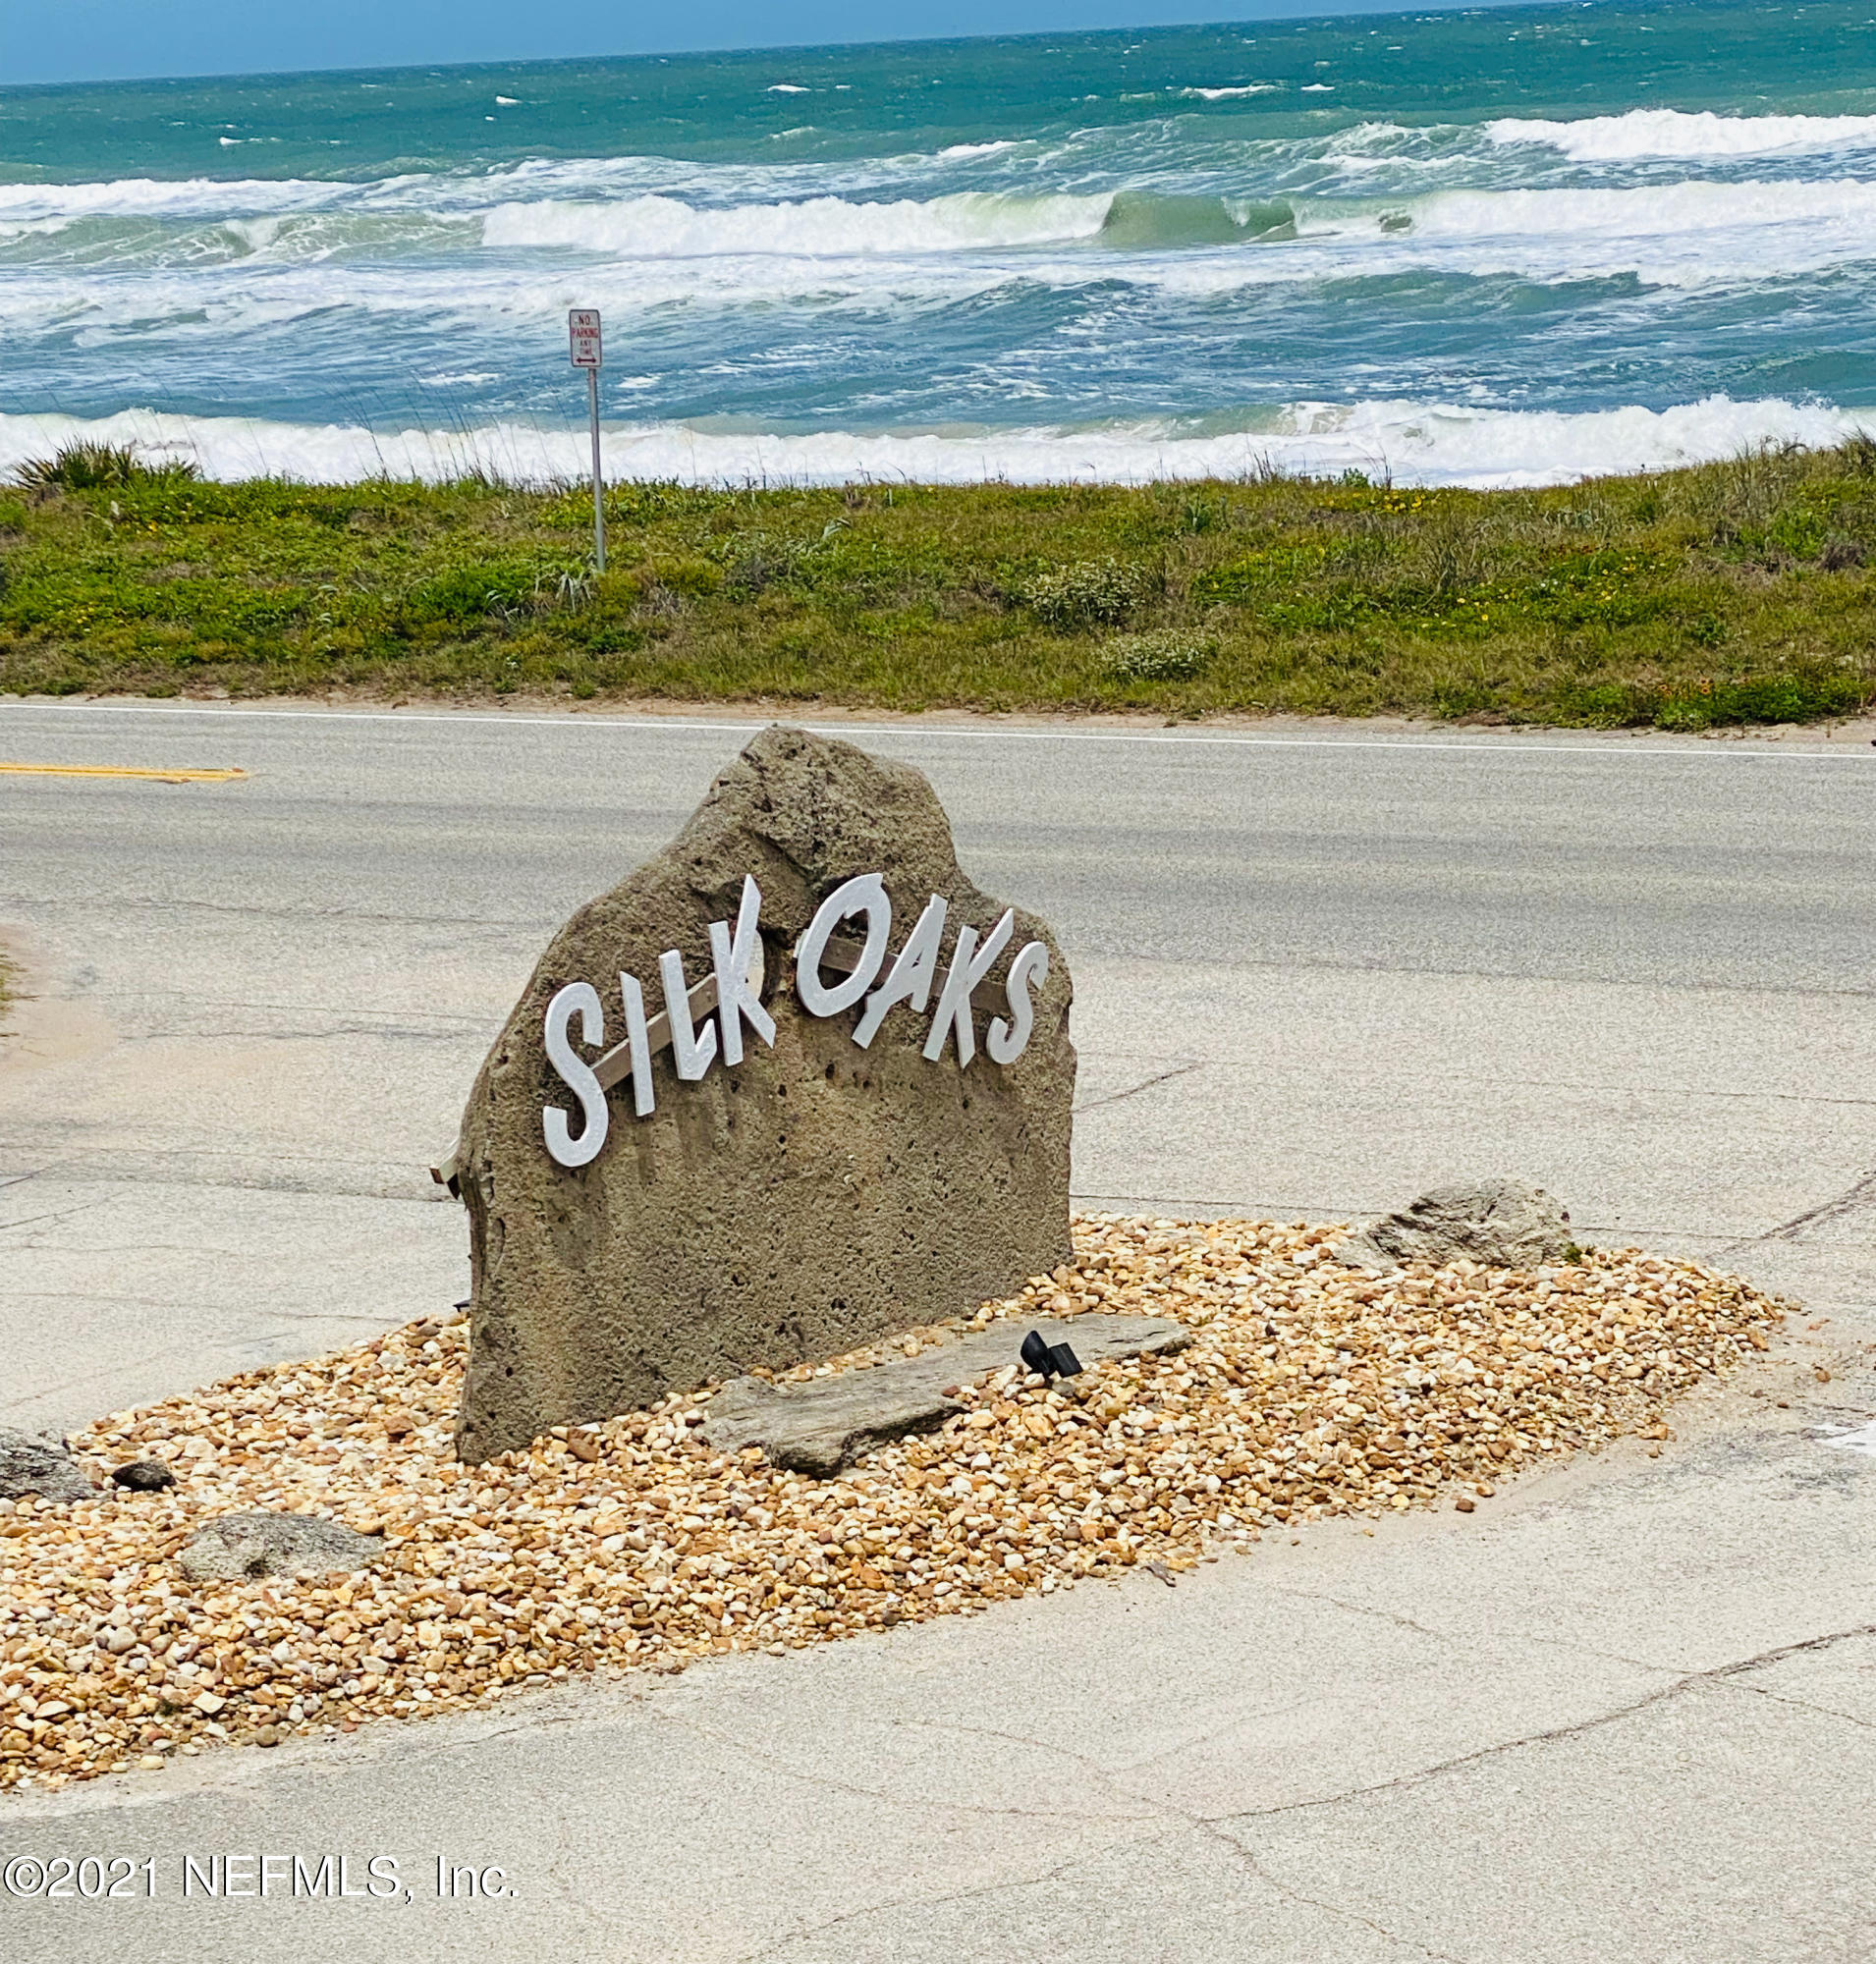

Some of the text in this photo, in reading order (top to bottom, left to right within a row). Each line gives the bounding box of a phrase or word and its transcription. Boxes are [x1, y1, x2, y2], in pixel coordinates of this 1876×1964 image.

[579, 314, 590, 325] NO
[571, 327, 599, 338] PARKING
[542, 873, 1050, 1168] SILK OAKS
